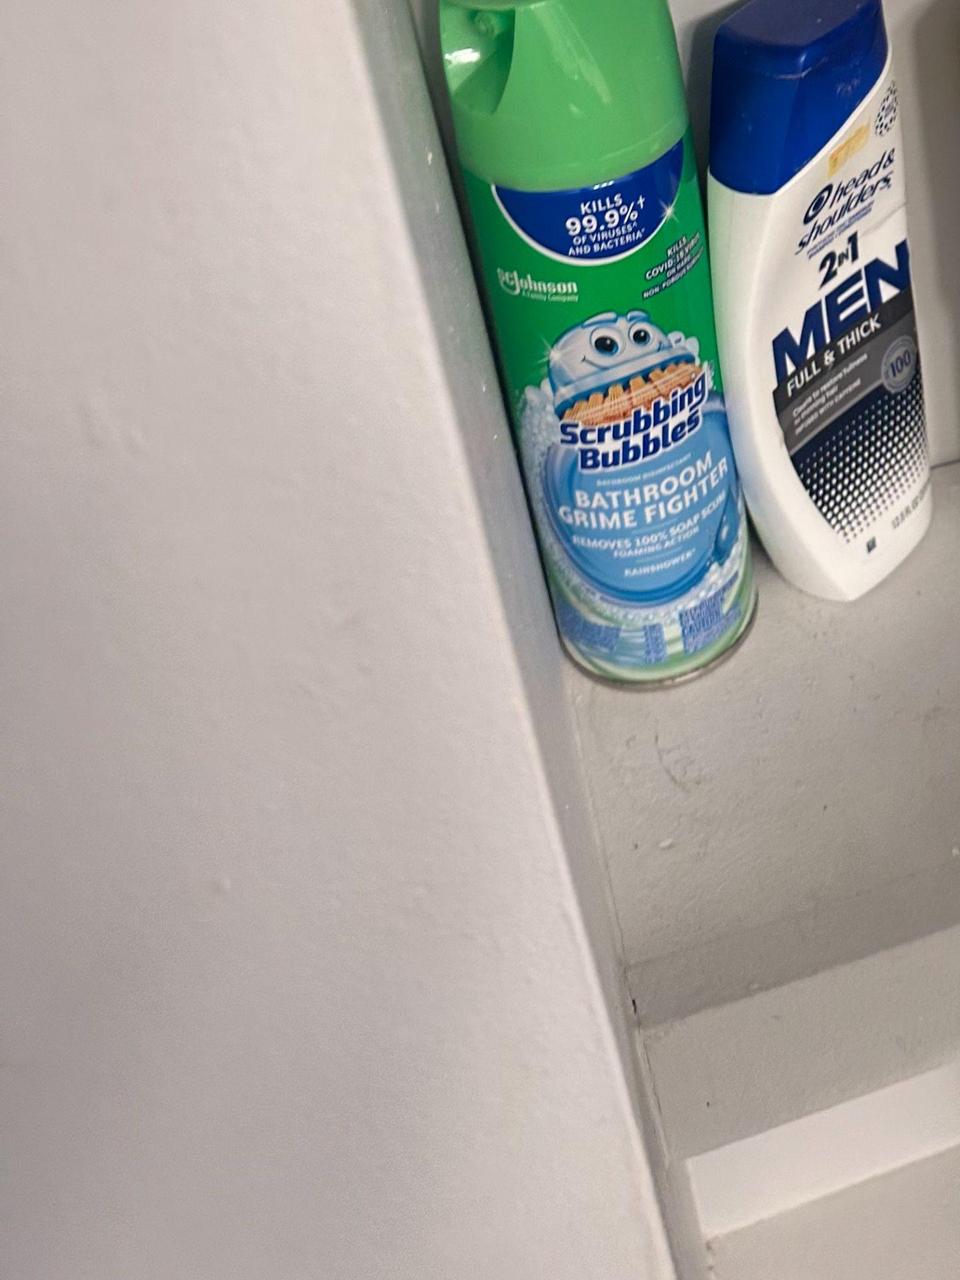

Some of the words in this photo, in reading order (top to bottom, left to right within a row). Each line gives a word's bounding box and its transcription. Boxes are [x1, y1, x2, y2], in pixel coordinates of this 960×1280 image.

[580, 193, 623, 215] KILLS
[568, 244, 591, 256] AND
[573, 235, 588, 246] OF
[771, 237, 911, 387] MEN
[786, 360, 822, 398] FULL
[823, 348, 836, 367] &
[836, 312, 882, 355] THICK
[890, 349, 912, 378] 100
[559, 371, 706, 446] Scrubbing
[579, 409, 700, 470] Bubbles
[558, 505, 638, 530] GRIME
[643, 456, 729, 524] FIGHTER
[574, 450, 713, 510] BATHROOM
[571, 534, 632, 550] REMOVES
[635, 530, 669, 546] 100%
[669, 514, 700, 537] SOAP
[701, 489, 727, 520] SCUM
[663, 525, 700, 549] ACTION
